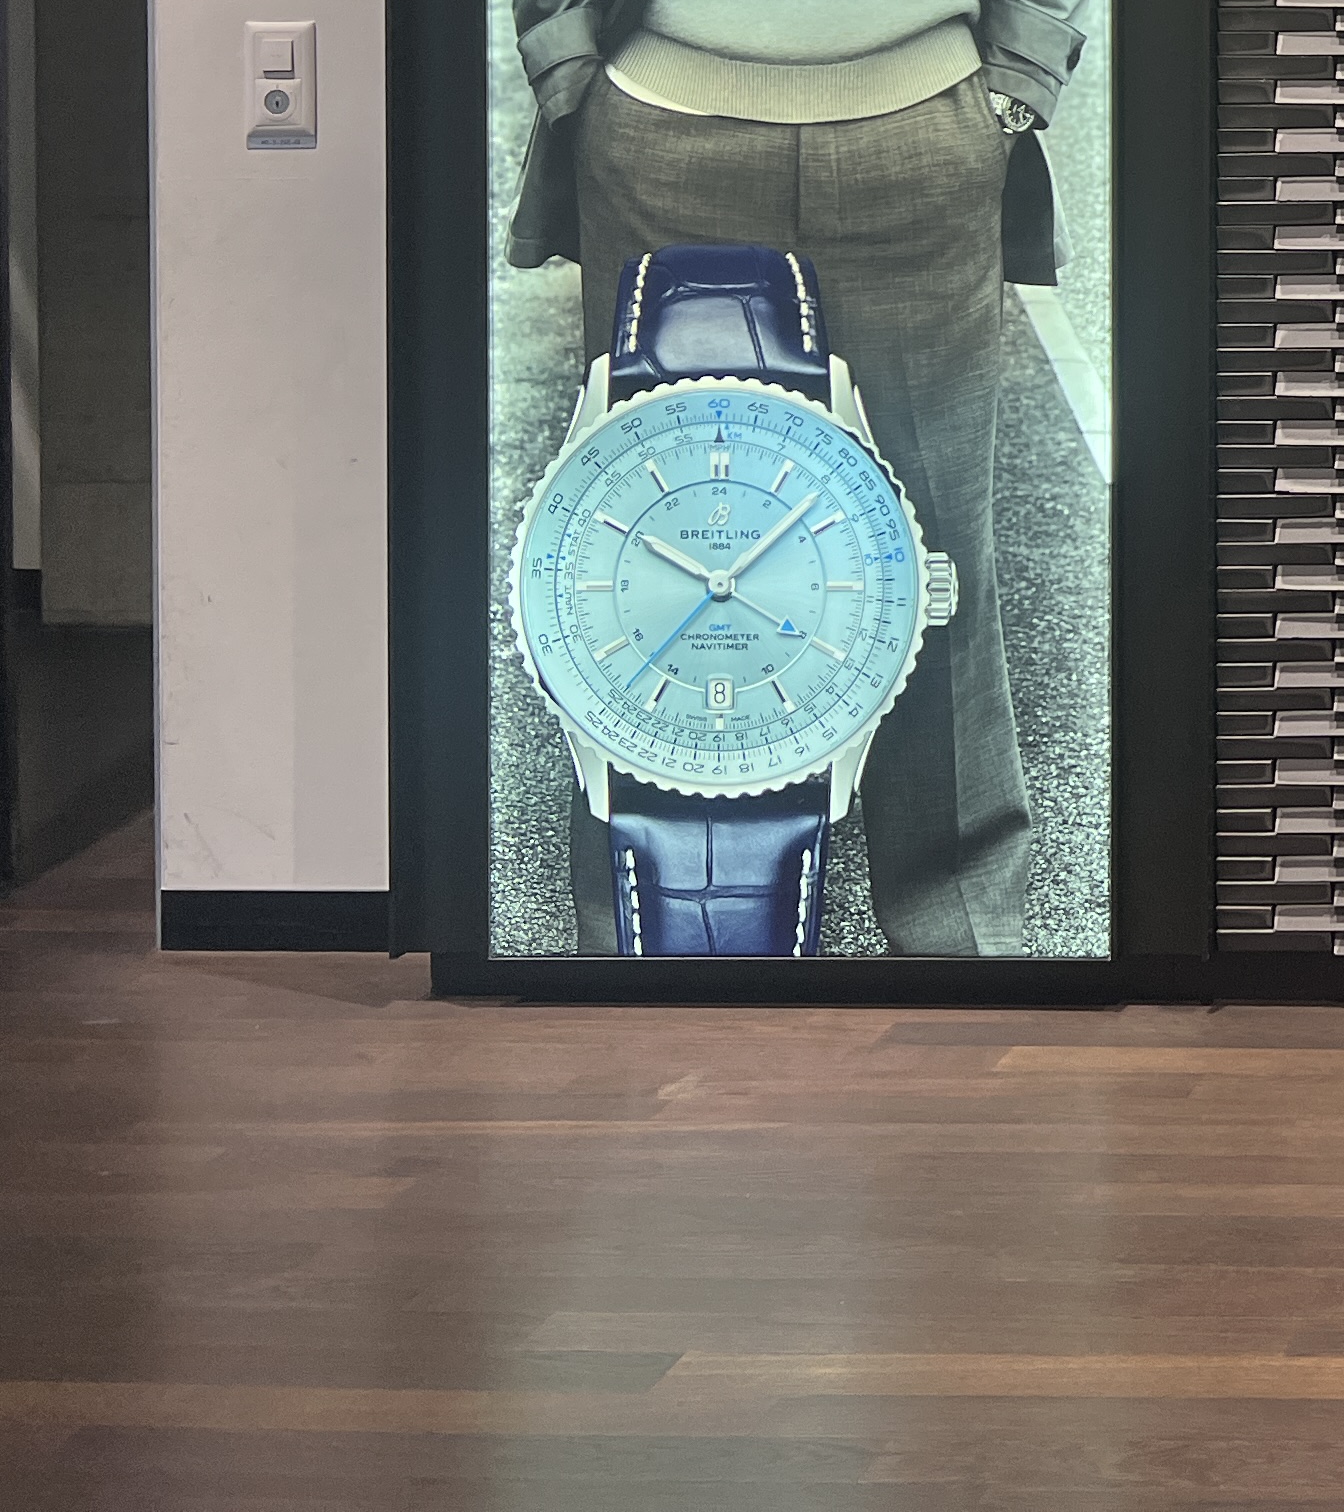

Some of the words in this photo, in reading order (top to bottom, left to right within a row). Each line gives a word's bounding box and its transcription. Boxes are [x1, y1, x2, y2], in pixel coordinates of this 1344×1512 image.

[665, 402, 687, 415] 55
[708, 399, 730, 408] 60
[747, 402, 769, 414] 65
[621, 417, 643, 434] 50
[784, 412, 804, 426] 70
[815, 427, 834, 445] 75
[581, 446, 600, 466] 45
[838, 448, 858, 467] 80
[859, 470, 877, 491] 85
[712, 487, 727, 495] 24
[548, 493, 564, 514] 40
[664, 498, 680, 511] 22
[762, 500, 772, 509] 2
[874, 495, 890, 517] 90
[680, 530, 760, 539] BREITLING
[886, 518, 900, 541] 95
[568, 531, 581, 556] STAT
[894, 547, 905, 563] 10
[532, 557, 542, 579] 35
[564, 585, 574, 616] NAUT
[680, 633, 759, 641] CHRONOMETER
[538, 633, 552, 656] 30
[691, 643, 748, 651] NAVITIMER
[887, 637, 899, 652] 12
[667, 664, 679, 675] 14
[761, 664, 774, 674] 10
[870, 674, 884, 688] 13
[714, 682, 726, 703] 8
[848, 703, 863, 718] 14
[584, 710, 603, 728] 25
[601, 725, 620, 741] 24
[822, 728, 837, 741] 15
[618, 737, 638, 751] 23
[795, 743, 810, 756] 16
[638, 749, 658, 761] 22
[768, 756, 782, 767] 17
[662, 757, 679, 768] 21
[683, 762, 704, 773] 20
[739, 763, 755, 773] 18
[712, 765, 727, 775] 19
